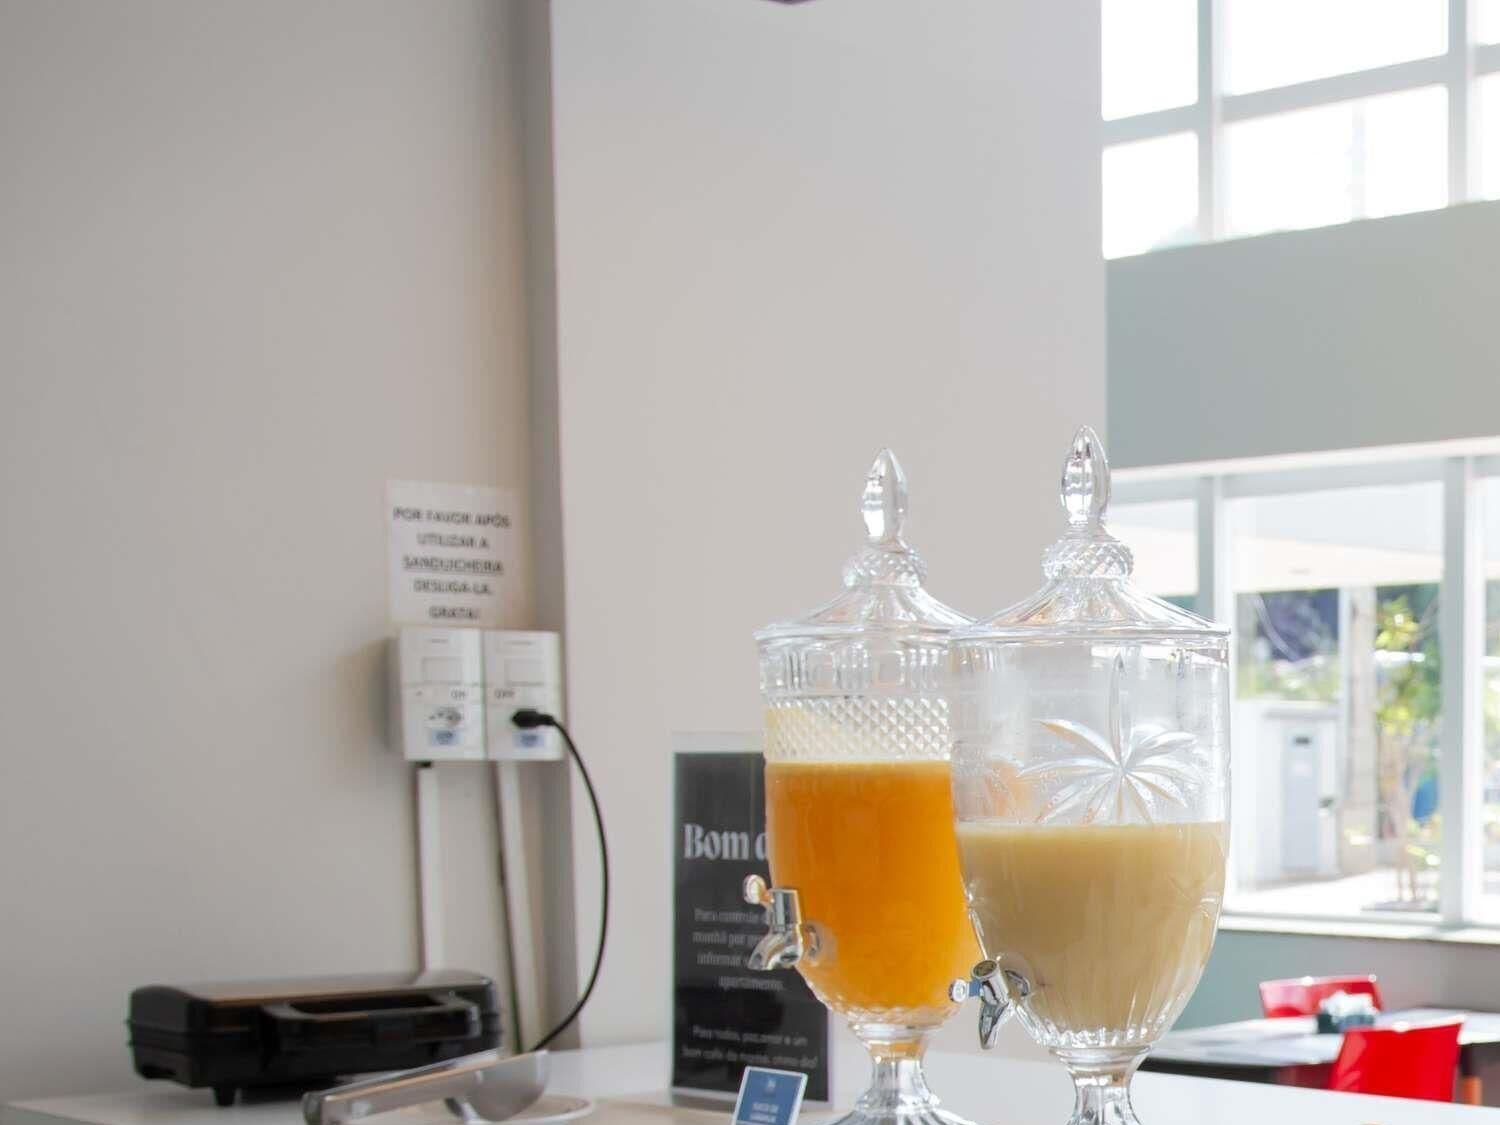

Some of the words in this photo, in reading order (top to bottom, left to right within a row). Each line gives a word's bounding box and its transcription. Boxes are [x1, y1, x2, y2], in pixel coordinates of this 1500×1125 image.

[393, 506, 421, 522] POR
[426, 509, 472, 527] FAVOR
[475, 512, 511, 529] APÓS
[416, 533, 475, 549] UTILIZAR
[683, 823, 749, 861] Bom
